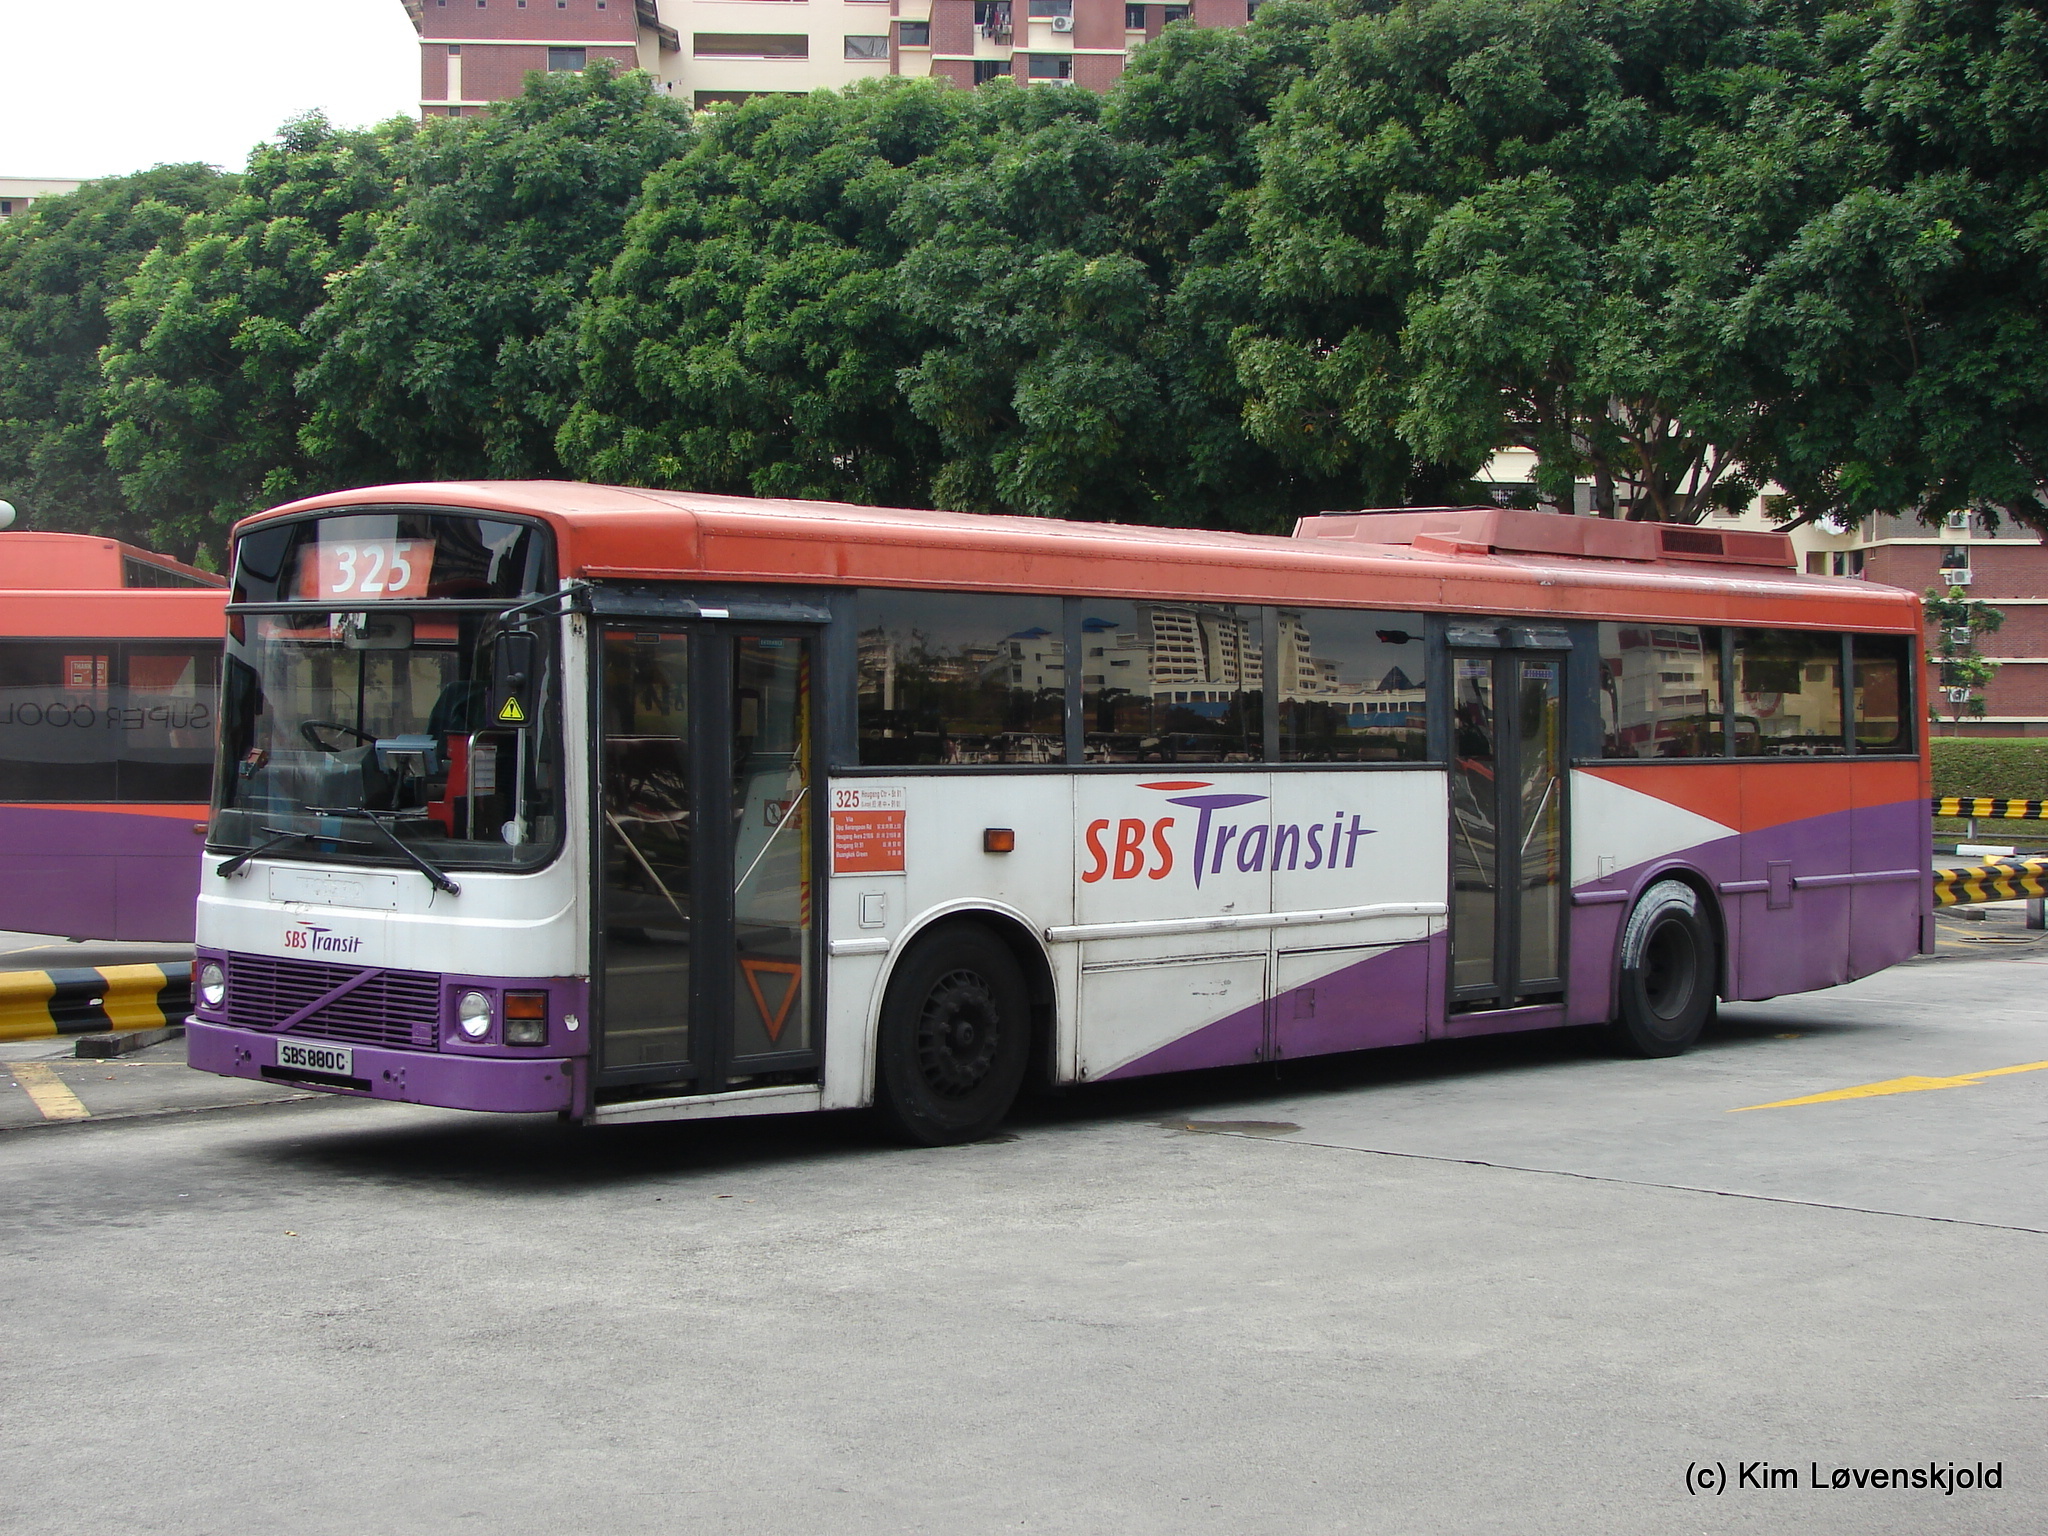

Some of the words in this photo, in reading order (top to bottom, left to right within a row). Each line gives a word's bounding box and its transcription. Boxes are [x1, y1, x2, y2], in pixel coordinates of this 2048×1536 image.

[331, 542, 412, 593] 325
[836, 790, 860, 808] 325
[1081, 816, 1175, 884] SBS
[1165, 793, 1379, 891] Transit
[284, 930, 307, 949] SBS
[306, 927, 364, 954] Transit
